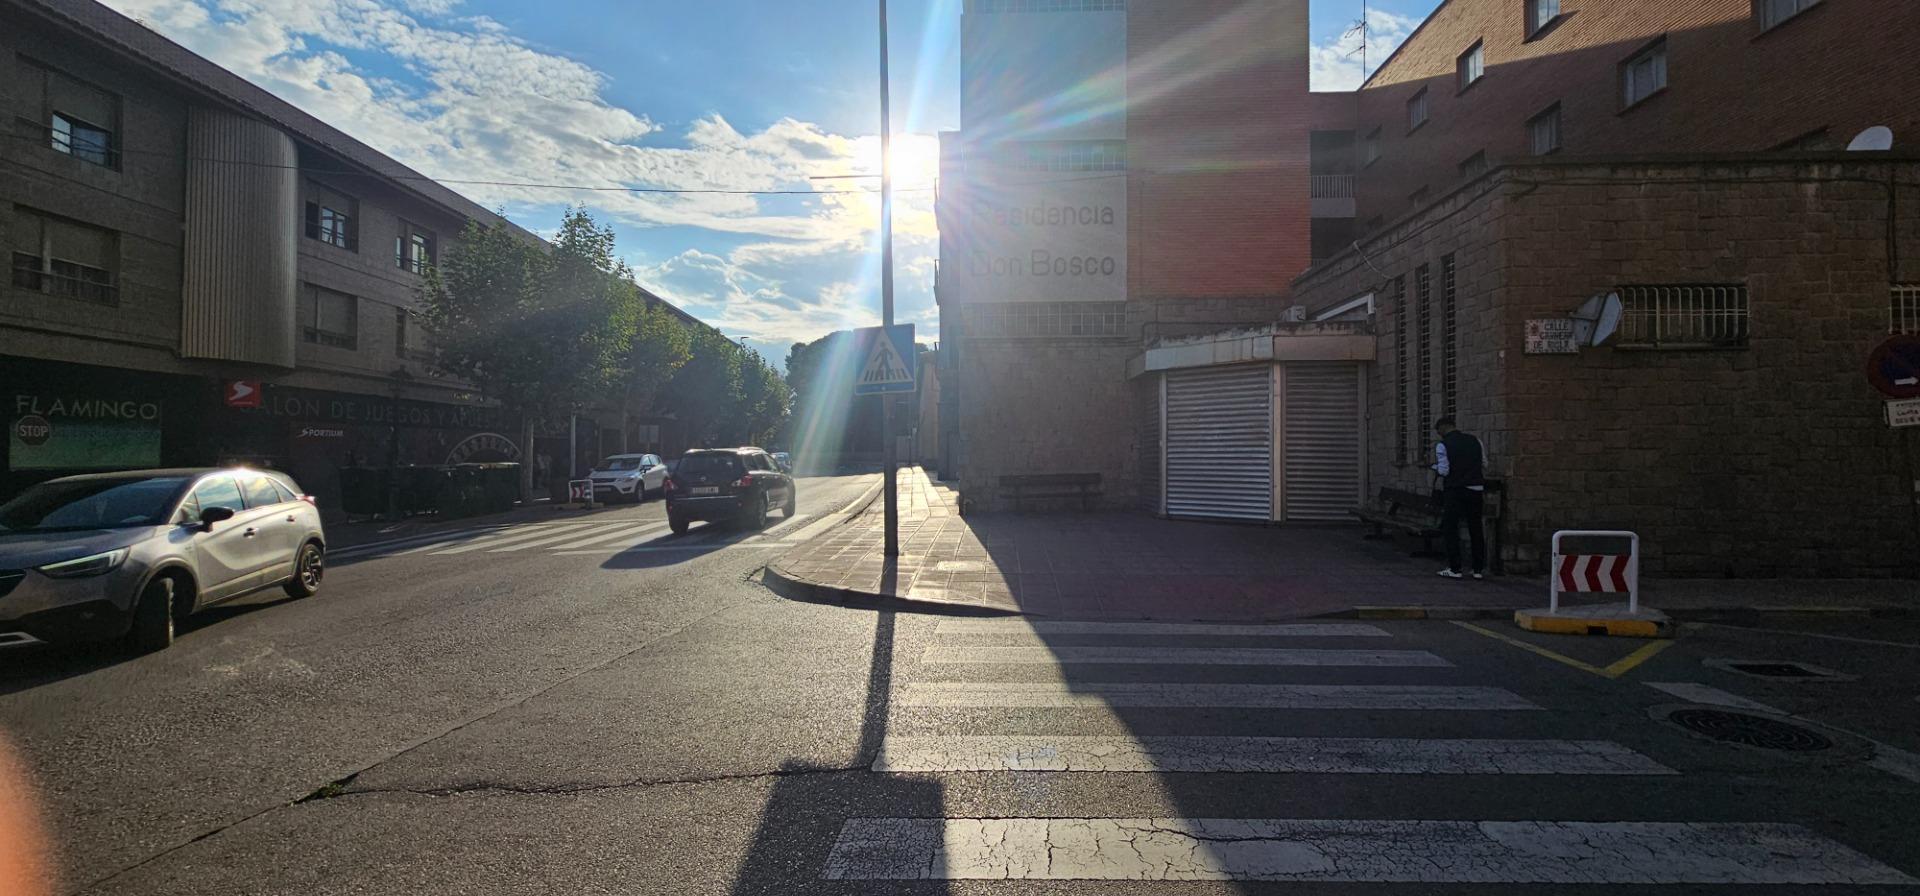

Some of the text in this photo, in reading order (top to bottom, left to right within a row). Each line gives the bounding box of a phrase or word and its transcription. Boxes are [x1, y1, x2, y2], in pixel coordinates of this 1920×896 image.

[971, 199, 1114, 225] Residencia
[971, 249, 1115, 276] Don Bosco
[15, 394, 158, 420] FLAMINGO
[331, 400, 356, 420] DE
[18, 424, 49, 438] STOP
